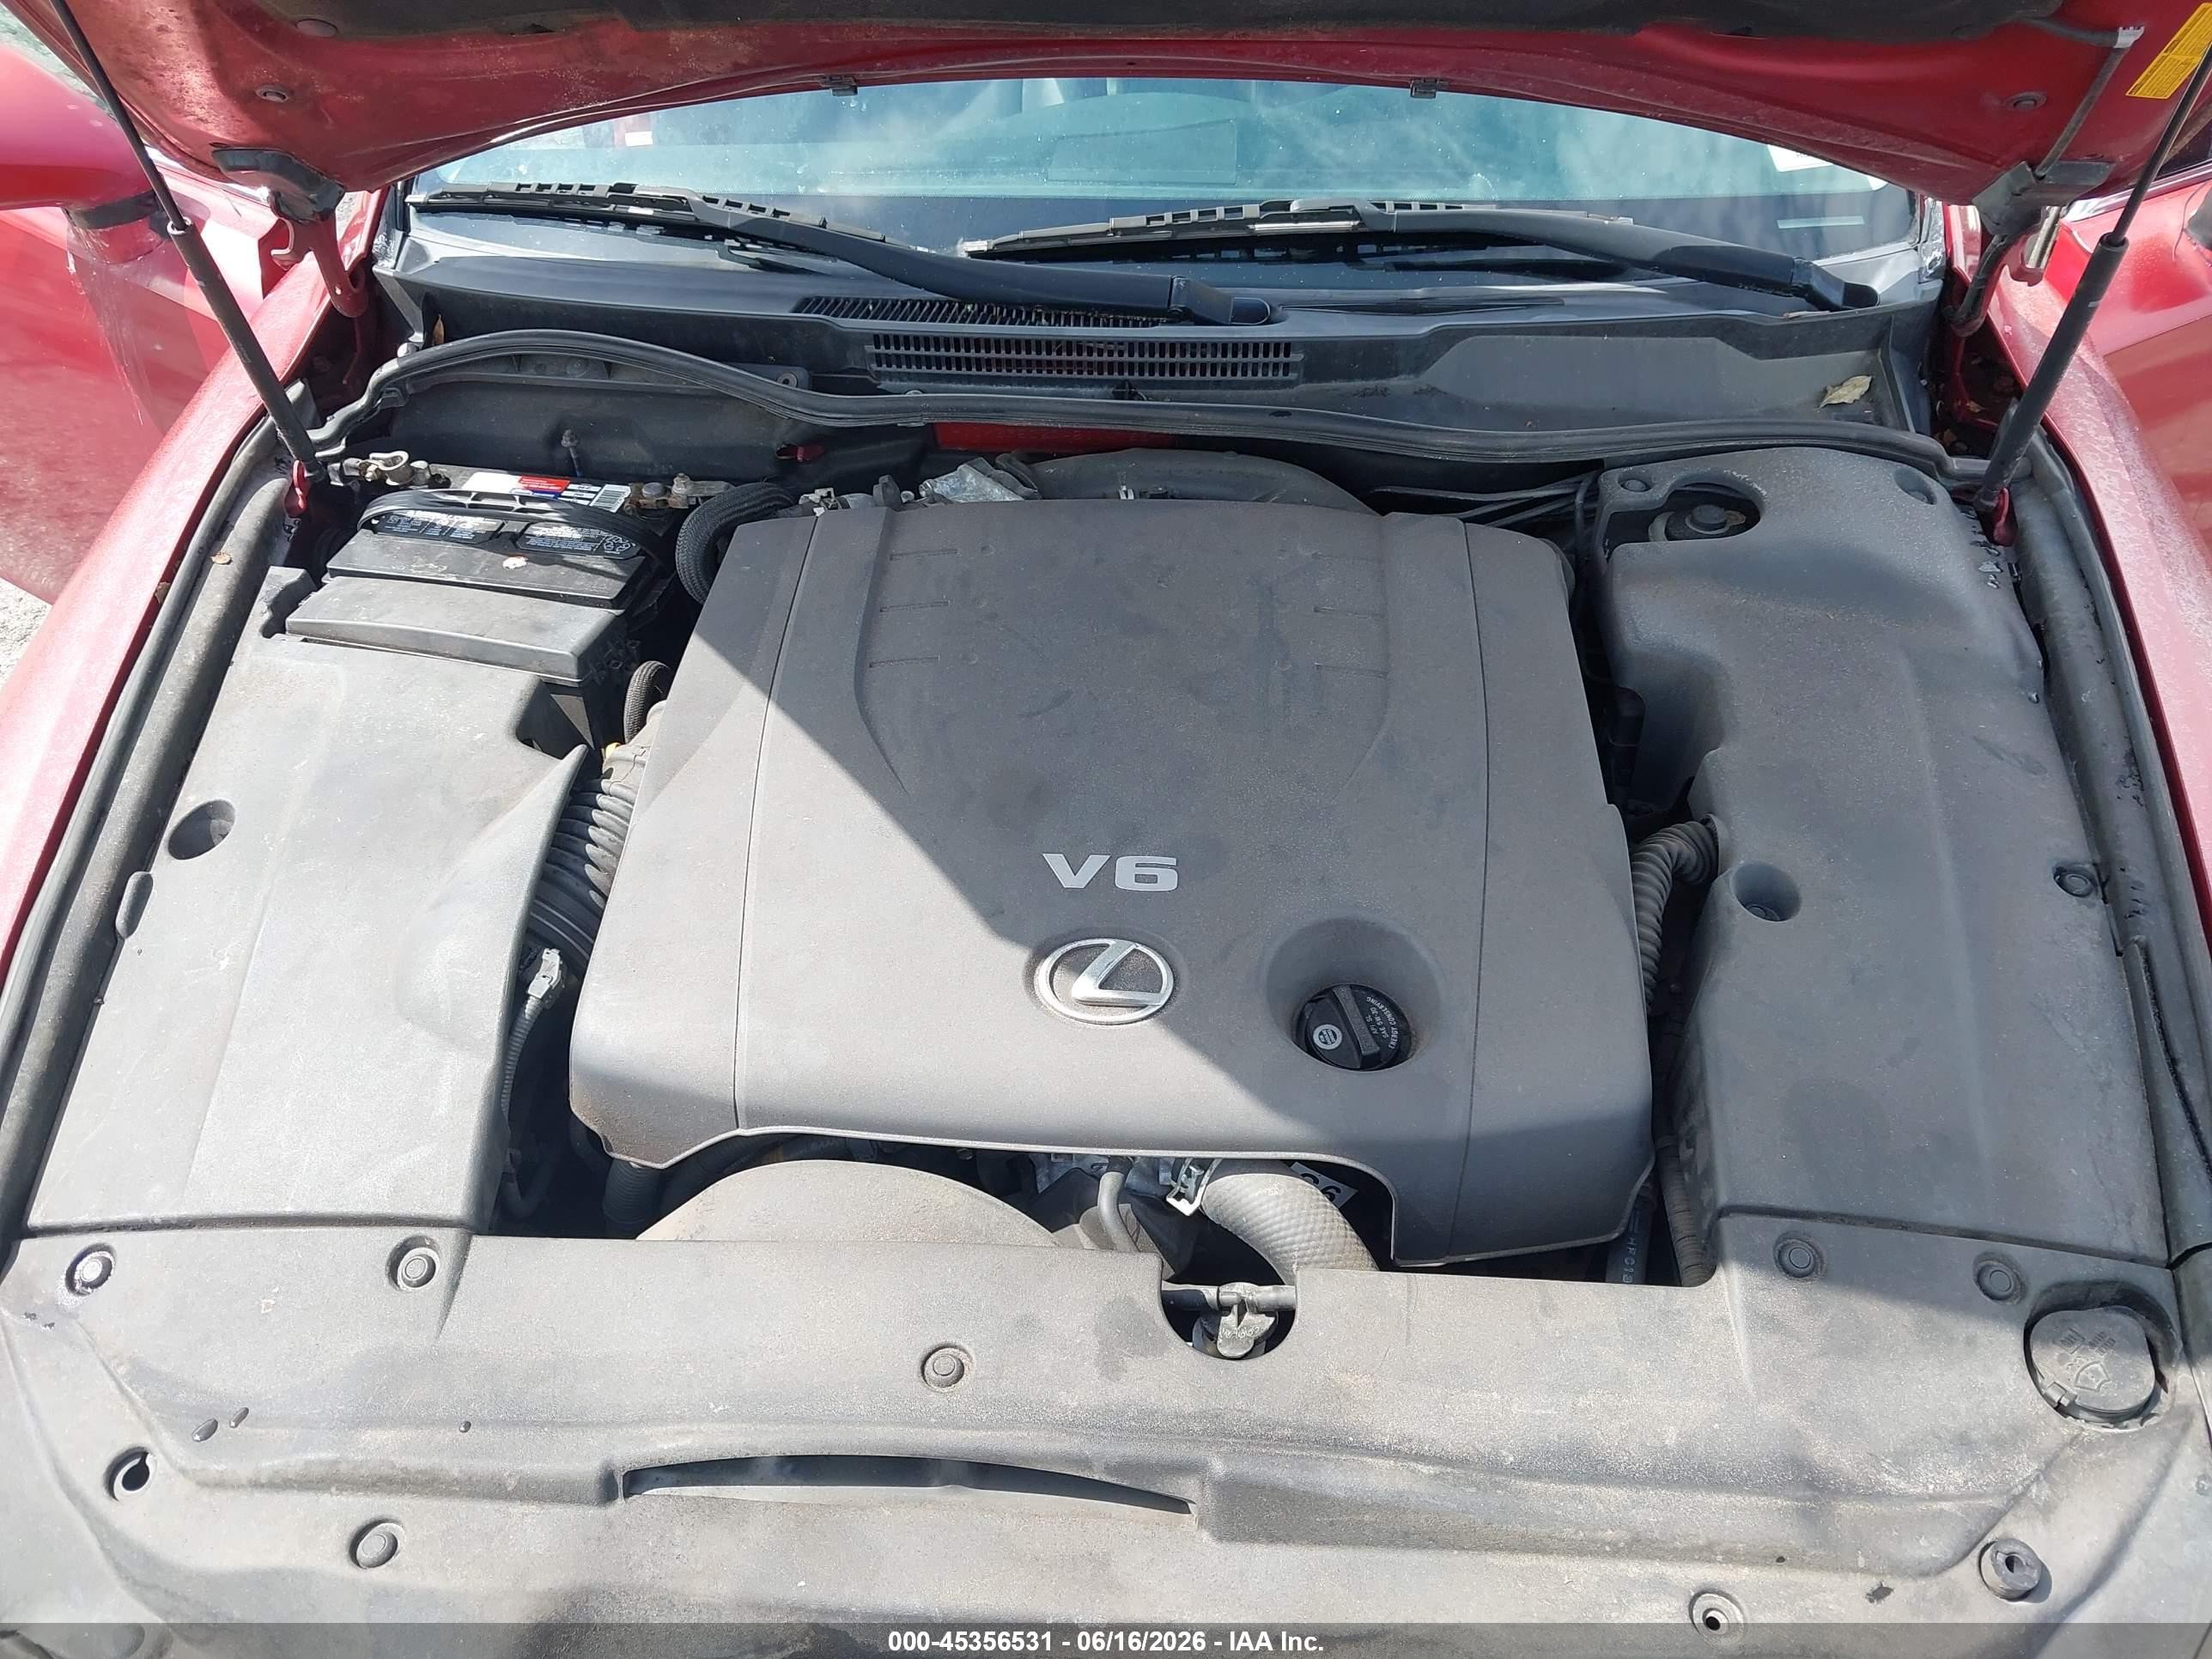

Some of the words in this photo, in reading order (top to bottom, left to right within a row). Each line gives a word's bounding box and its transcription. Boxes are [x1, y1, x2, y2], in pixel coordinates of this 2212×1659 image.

[1042, 853, 1179, 892] V6
[1366, 996, 1397, 1025] CONSERVING
[1378, 1026, 1389, 1038] SAE
[1388, 1026, 1399, 1049] ENERGY
